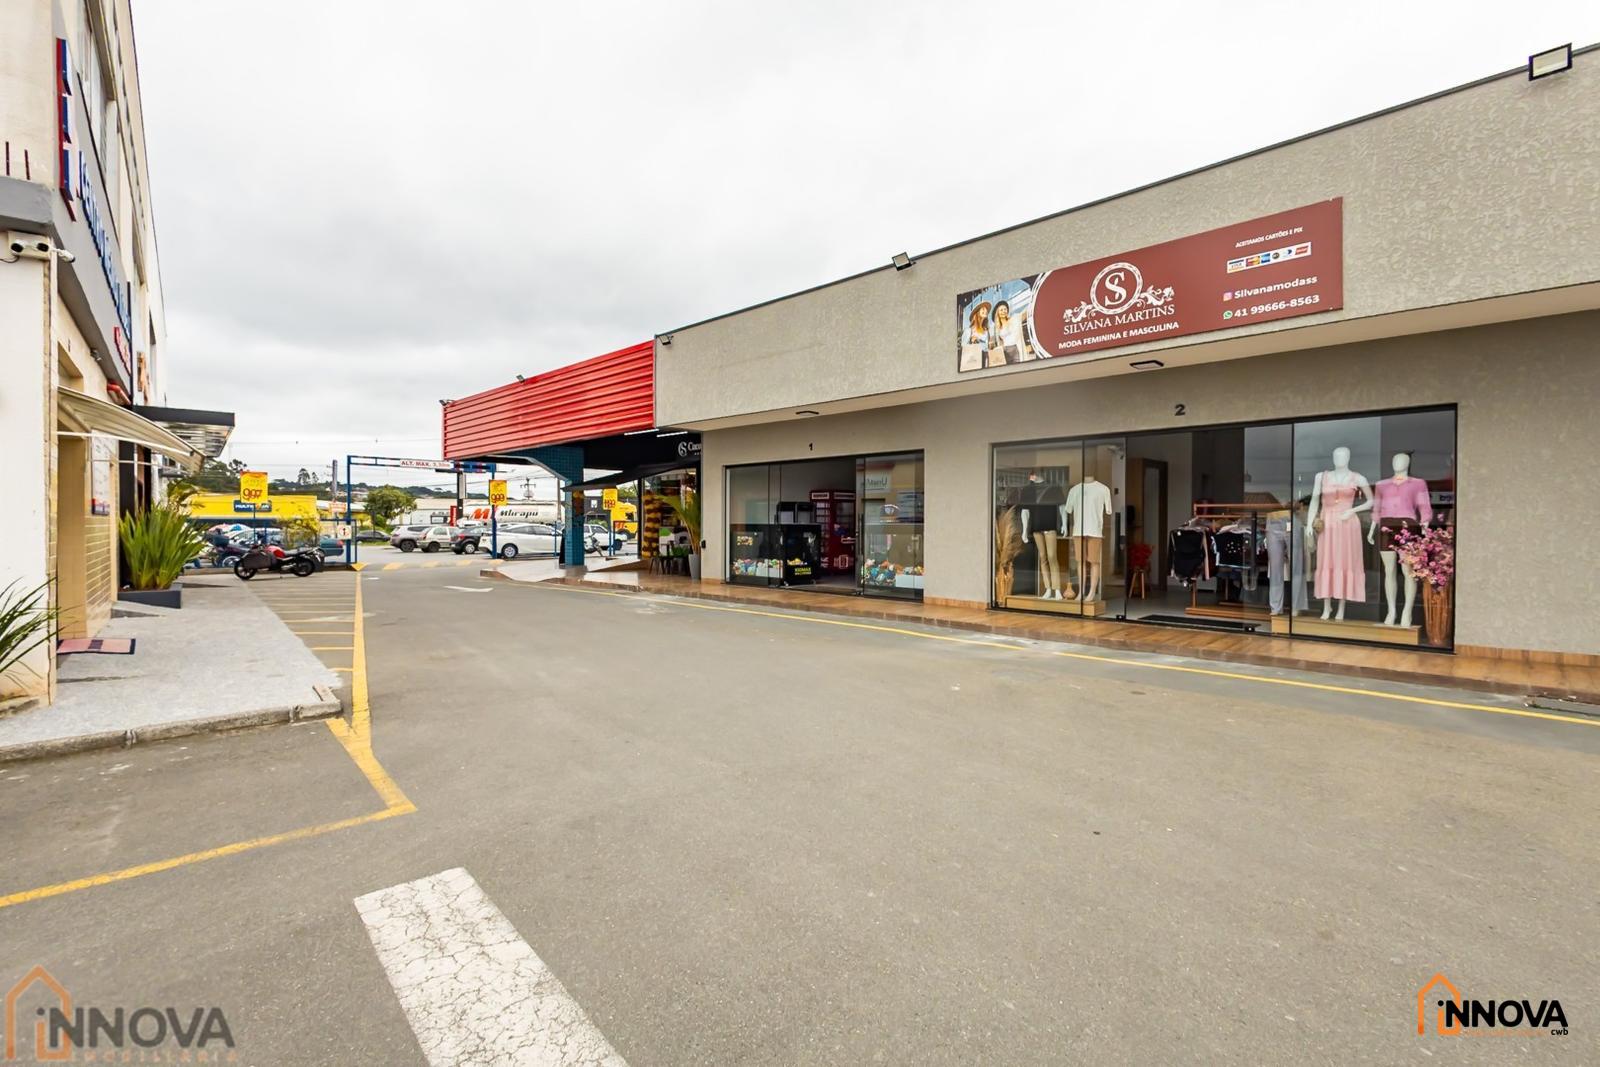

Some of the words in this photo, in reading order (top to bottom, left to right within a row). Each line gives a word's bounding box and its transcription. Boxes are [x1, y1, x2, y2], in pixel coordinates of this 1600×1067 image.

[1234, 276, 1318, 299] Silvanamodass
[1234, 308, 1248, 317] 41
[1250, 294, 1320, 315] 99666-8563
[1063, 318, 1112, 335] SILVANA
[1114, 304, 1175, 326] MARTINS
[1058, 339, 1082, 349] MODA
[1083, 332, 1121, 345] FEMININA
[1129, 321, 1179, 337] MASCULINA
[1174, 404, 1186, 416] 2
[808, 442, 814, 451] 1
